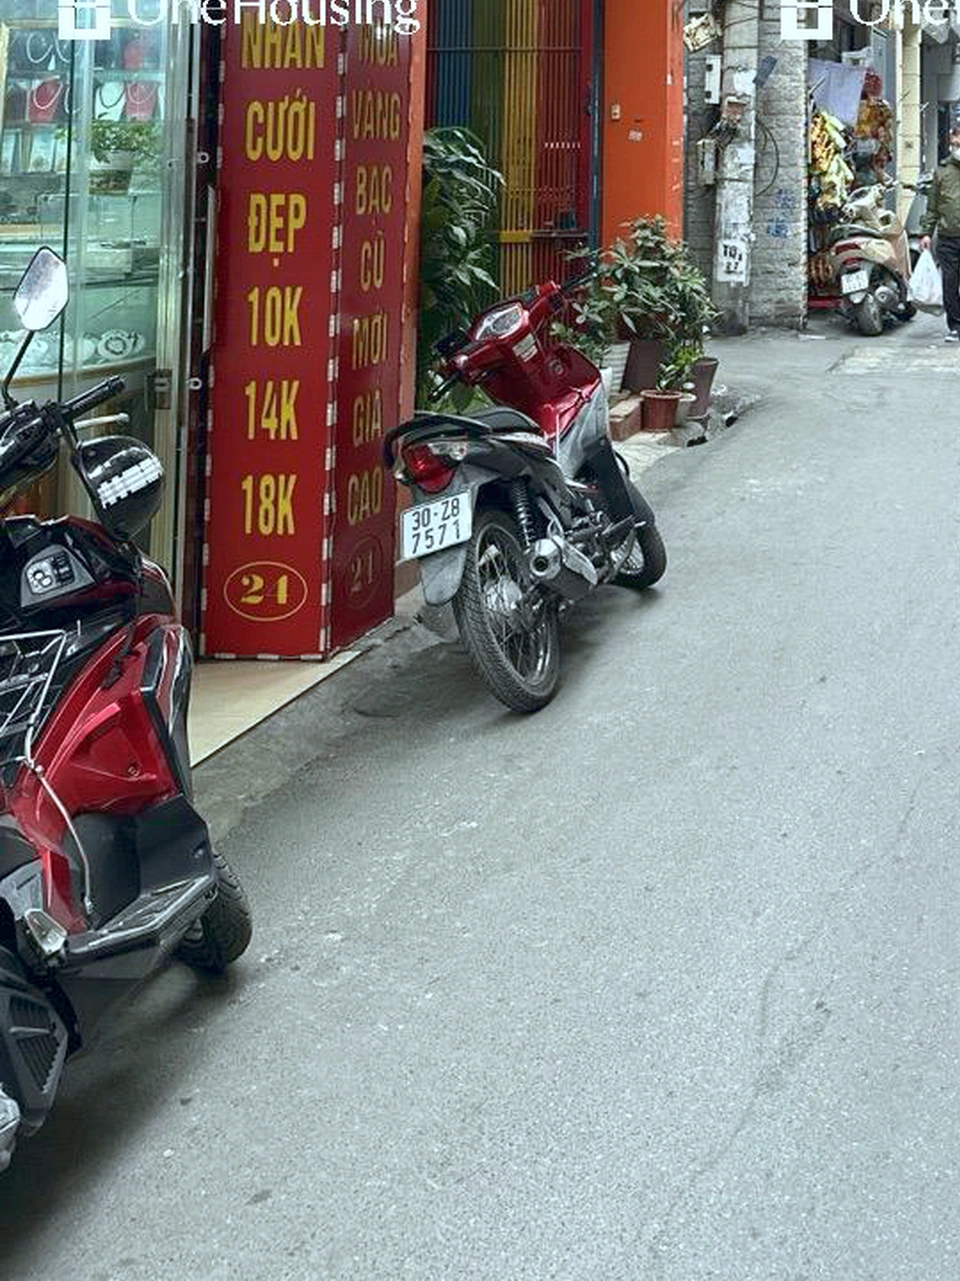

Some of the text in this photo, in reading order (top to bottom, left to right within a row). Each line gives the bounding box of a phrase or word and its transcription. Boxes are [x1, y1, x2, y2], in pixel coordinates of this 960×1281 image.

[246, 87, 315, 161] CƯỚI
[356, 166, 393, 225] BẠC
[248, 193, 306, 267] ĐẸP
[360, 230, 385, 291] CŨ
[247, 286, 303, 347] 10K
[244, 380, 299, 441] 14K
[242, 474, 297, 535] 18K
[347, 467, 383, 525] CAO
[412, 519, 460, 555] 7571
[240, 574, 289, 605] 24
